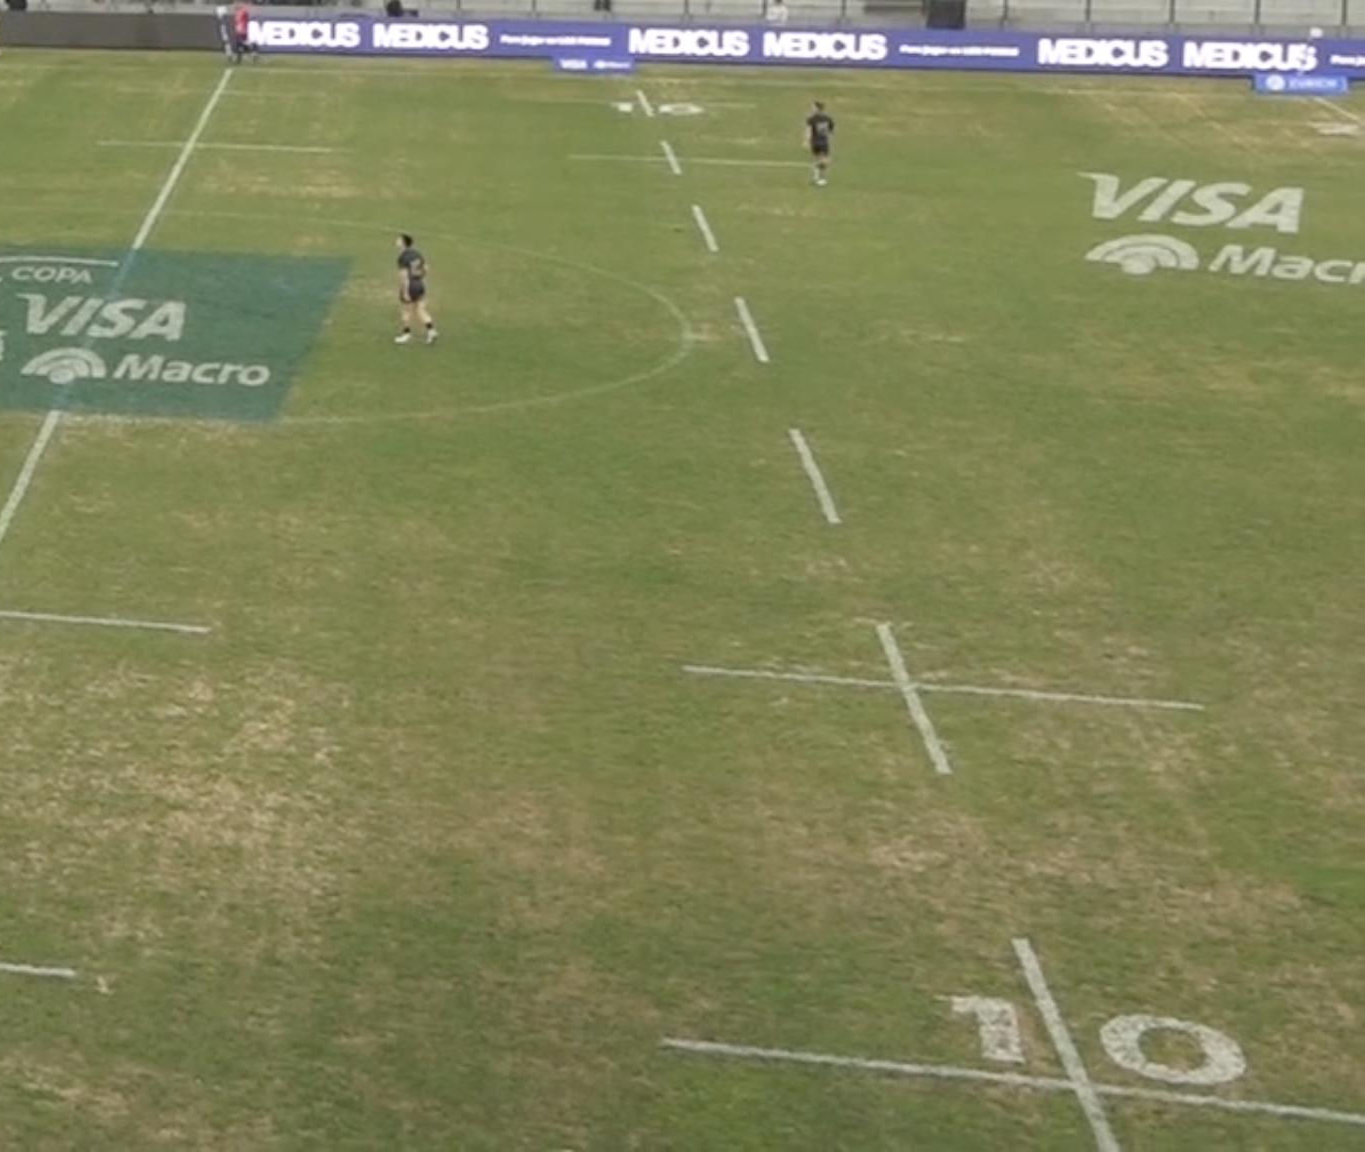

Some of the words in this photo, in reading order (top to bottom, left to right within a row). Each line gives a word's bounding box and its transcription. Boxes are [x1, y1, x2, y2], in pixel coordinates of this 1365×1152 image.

[247, 19, 361, 47] MEDICUS
[373, 22, 489, 50] MEDICUS
[629, 28, 750, 56] MEDICUS
[763, 31, 887, 60] MEDICUS
[1037, 38, 1168, 67] MEDICUS
[1183, 41, 1317, 70] MEDICUS
[1077, 173, 1305, 234] VISA
[11, 264, 93, 285] COPA
[1207, 244, 1365, 285] Macr
[16, 293, 187, 341] VISA
[113, 353, 270, 387] Macro
[933, 994, 1247, 1085] 10
